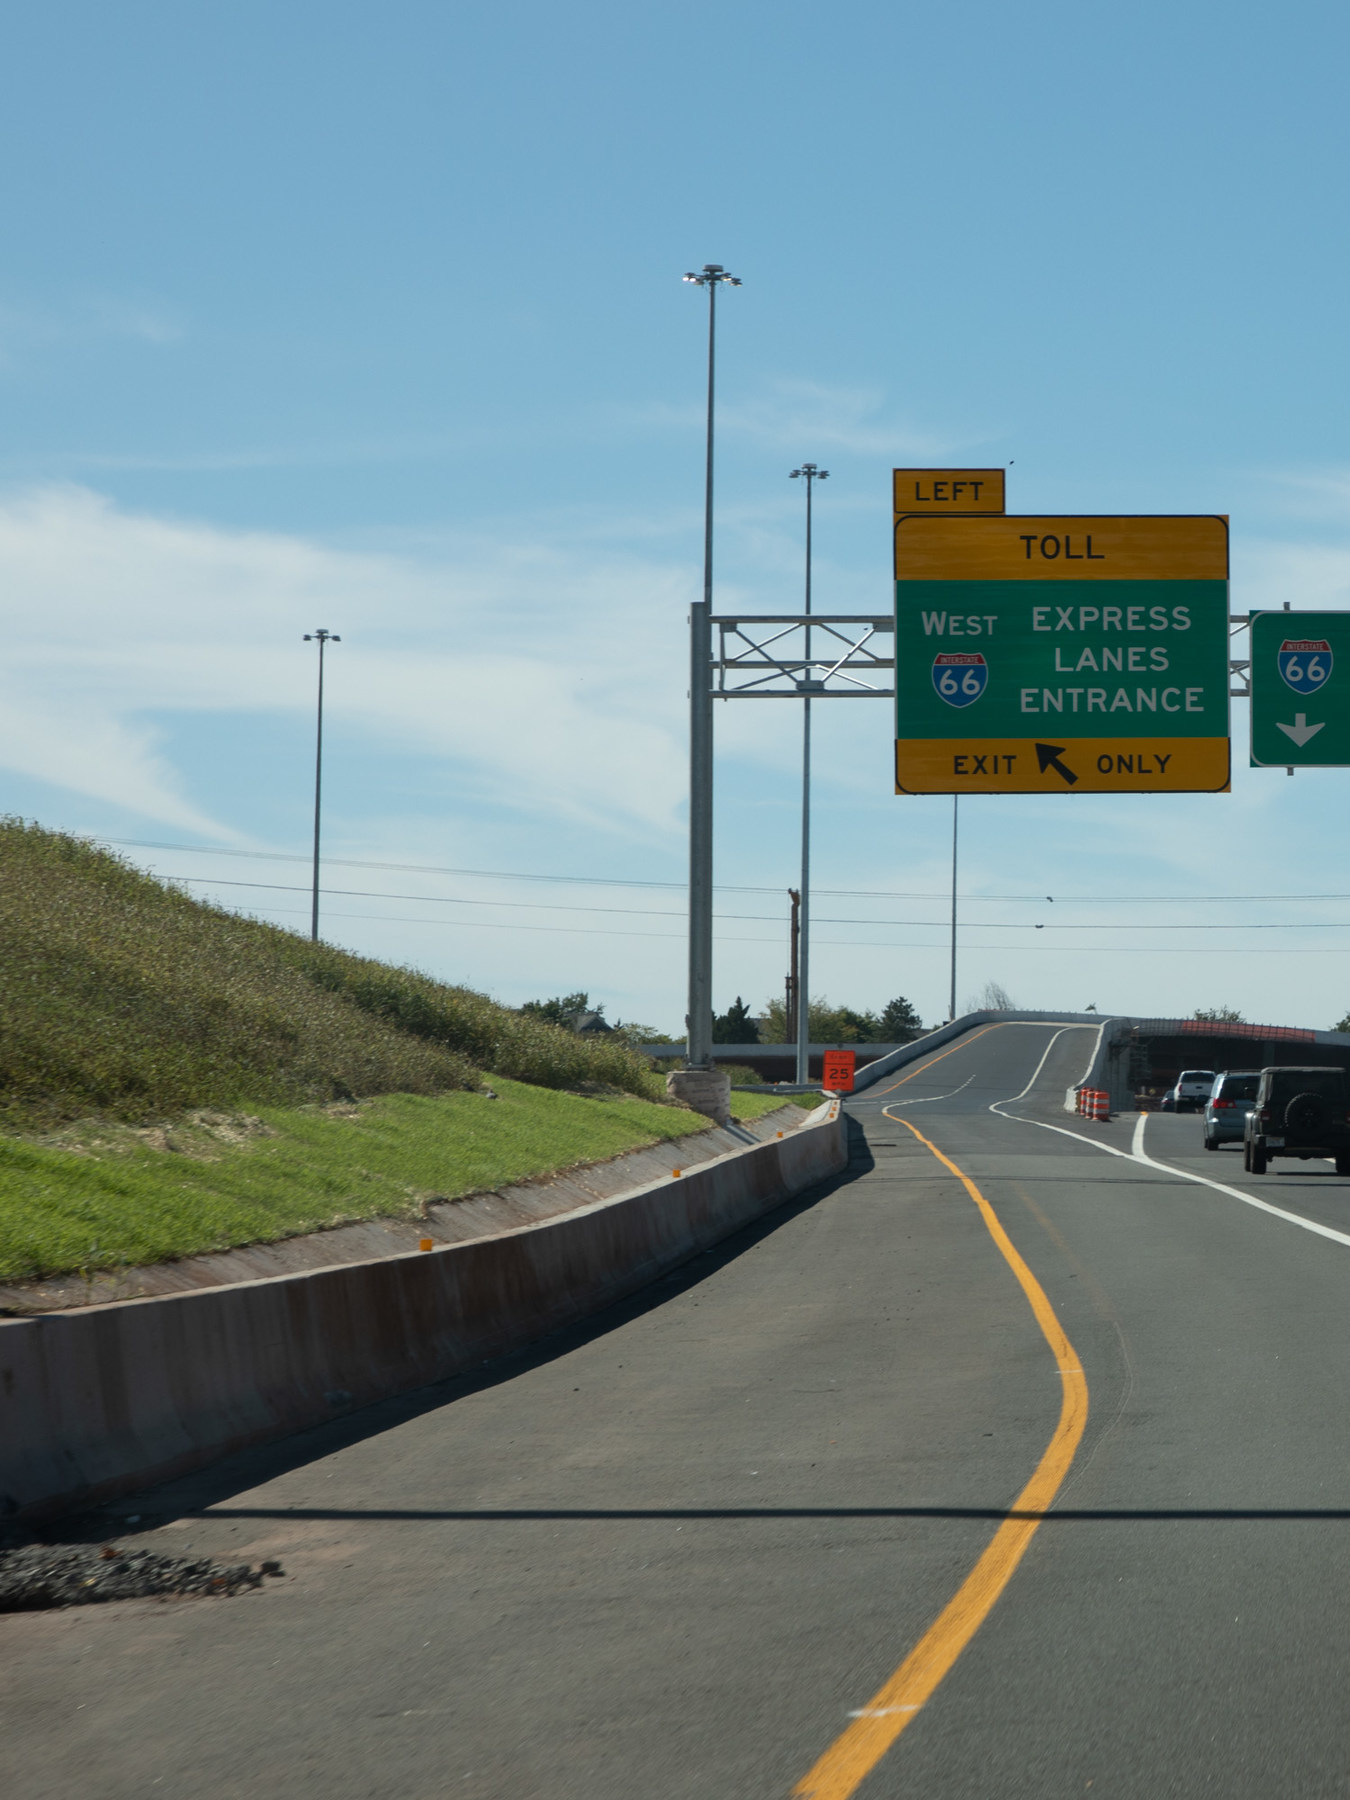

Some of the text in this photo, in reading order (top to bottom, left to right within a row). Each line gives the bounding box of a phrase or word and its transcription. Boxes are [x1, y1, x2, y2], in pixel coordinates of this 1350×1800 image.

[915, 481, 984, 502] LEFT
[1019, 534, 1106, 560] TOLL
[921, 611, 998, 636] WEST
[1032, 605, 1192, 631] EXPRESS
[940, 655, 980, 664] INTERSTATE
[1055, 646, 1169, 672] LANES
[1286, 655, 1326, 682] 66
[940, 668, 981, 696] 66
[1020, 687, 1204, 713] ENTRANCE
[953, 754, 1172, 776] EXIT ONLY
[829, 1068, 849, 1080] 25
